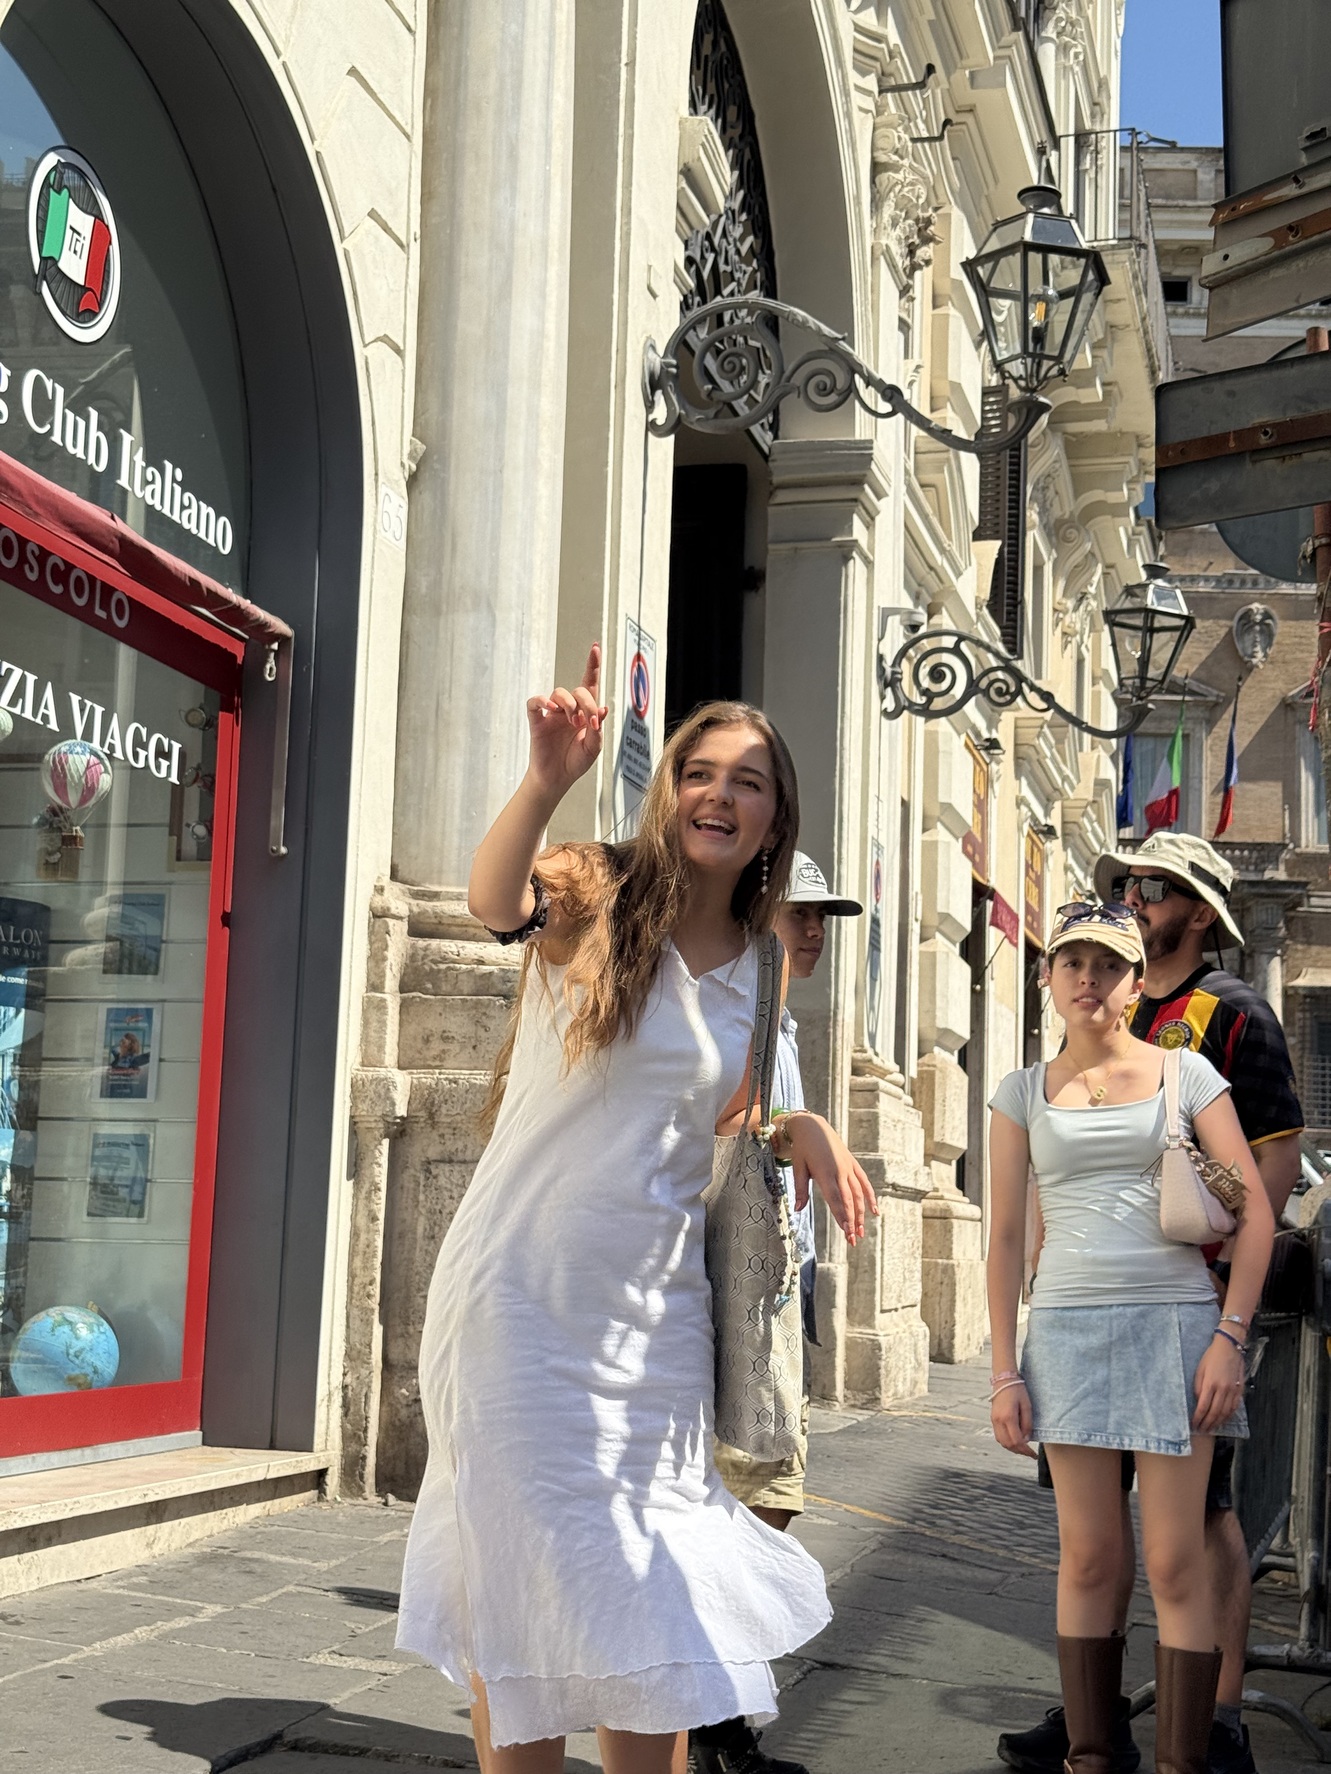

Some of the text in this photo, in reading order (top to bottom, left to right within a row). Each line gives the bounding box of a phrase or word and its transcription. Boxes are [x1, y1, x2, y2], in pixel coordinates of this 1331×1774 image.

[22, 368, 109, 472] Club
[116, 428, 233, 555] Italiano
[0, 527, 130, 628] OSCOLO
[69, 692, 182, 785] VIAGGI
